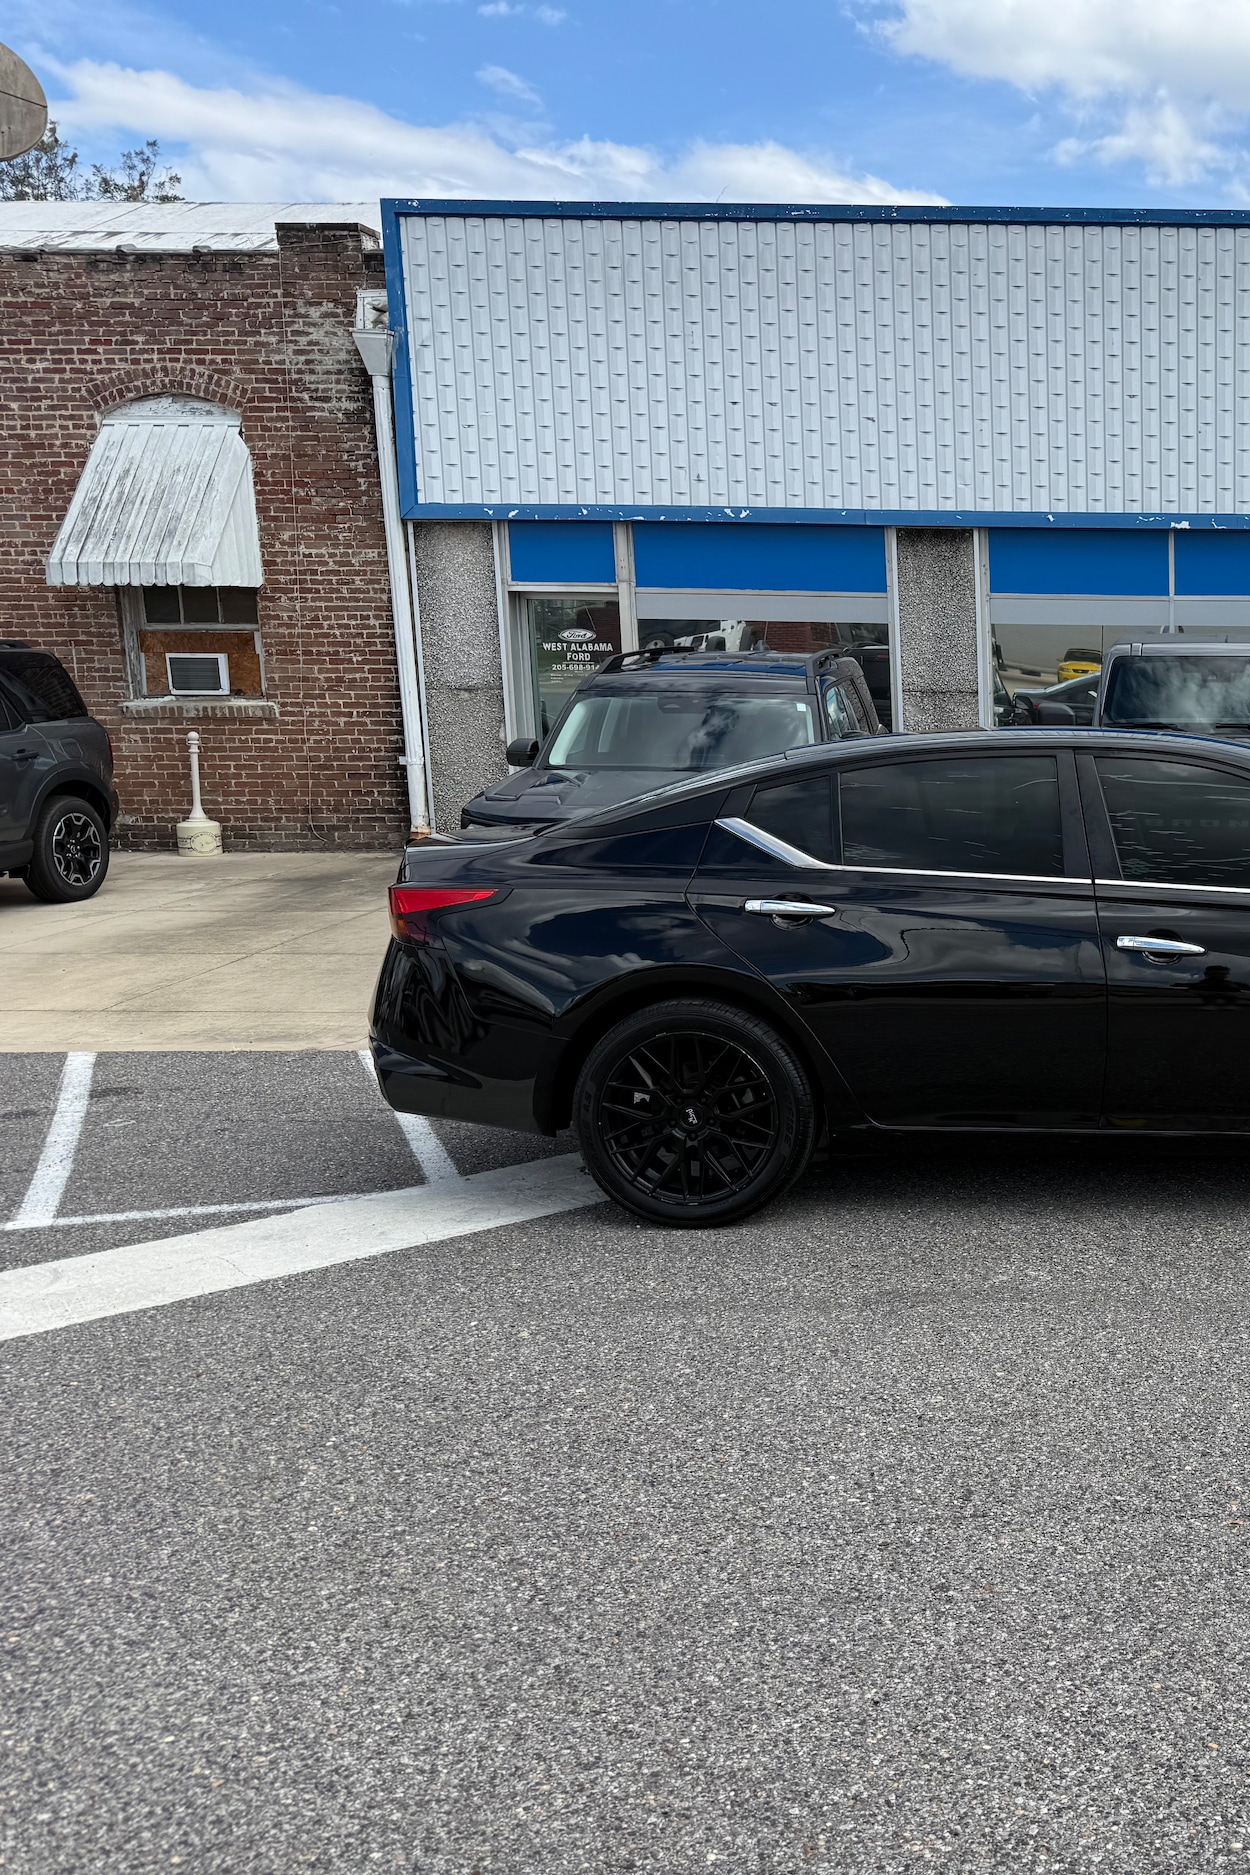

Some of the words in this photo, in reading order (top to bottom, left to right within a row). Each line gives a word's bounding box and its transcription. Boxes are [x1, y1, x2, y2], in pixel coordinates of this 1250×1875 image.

[566, 631, 588, 639] Ford
[542, 642, 568, 651] WEST
[570, 643, 613, 651] ALABAMA
[566, 652, 591, 661] FORD
